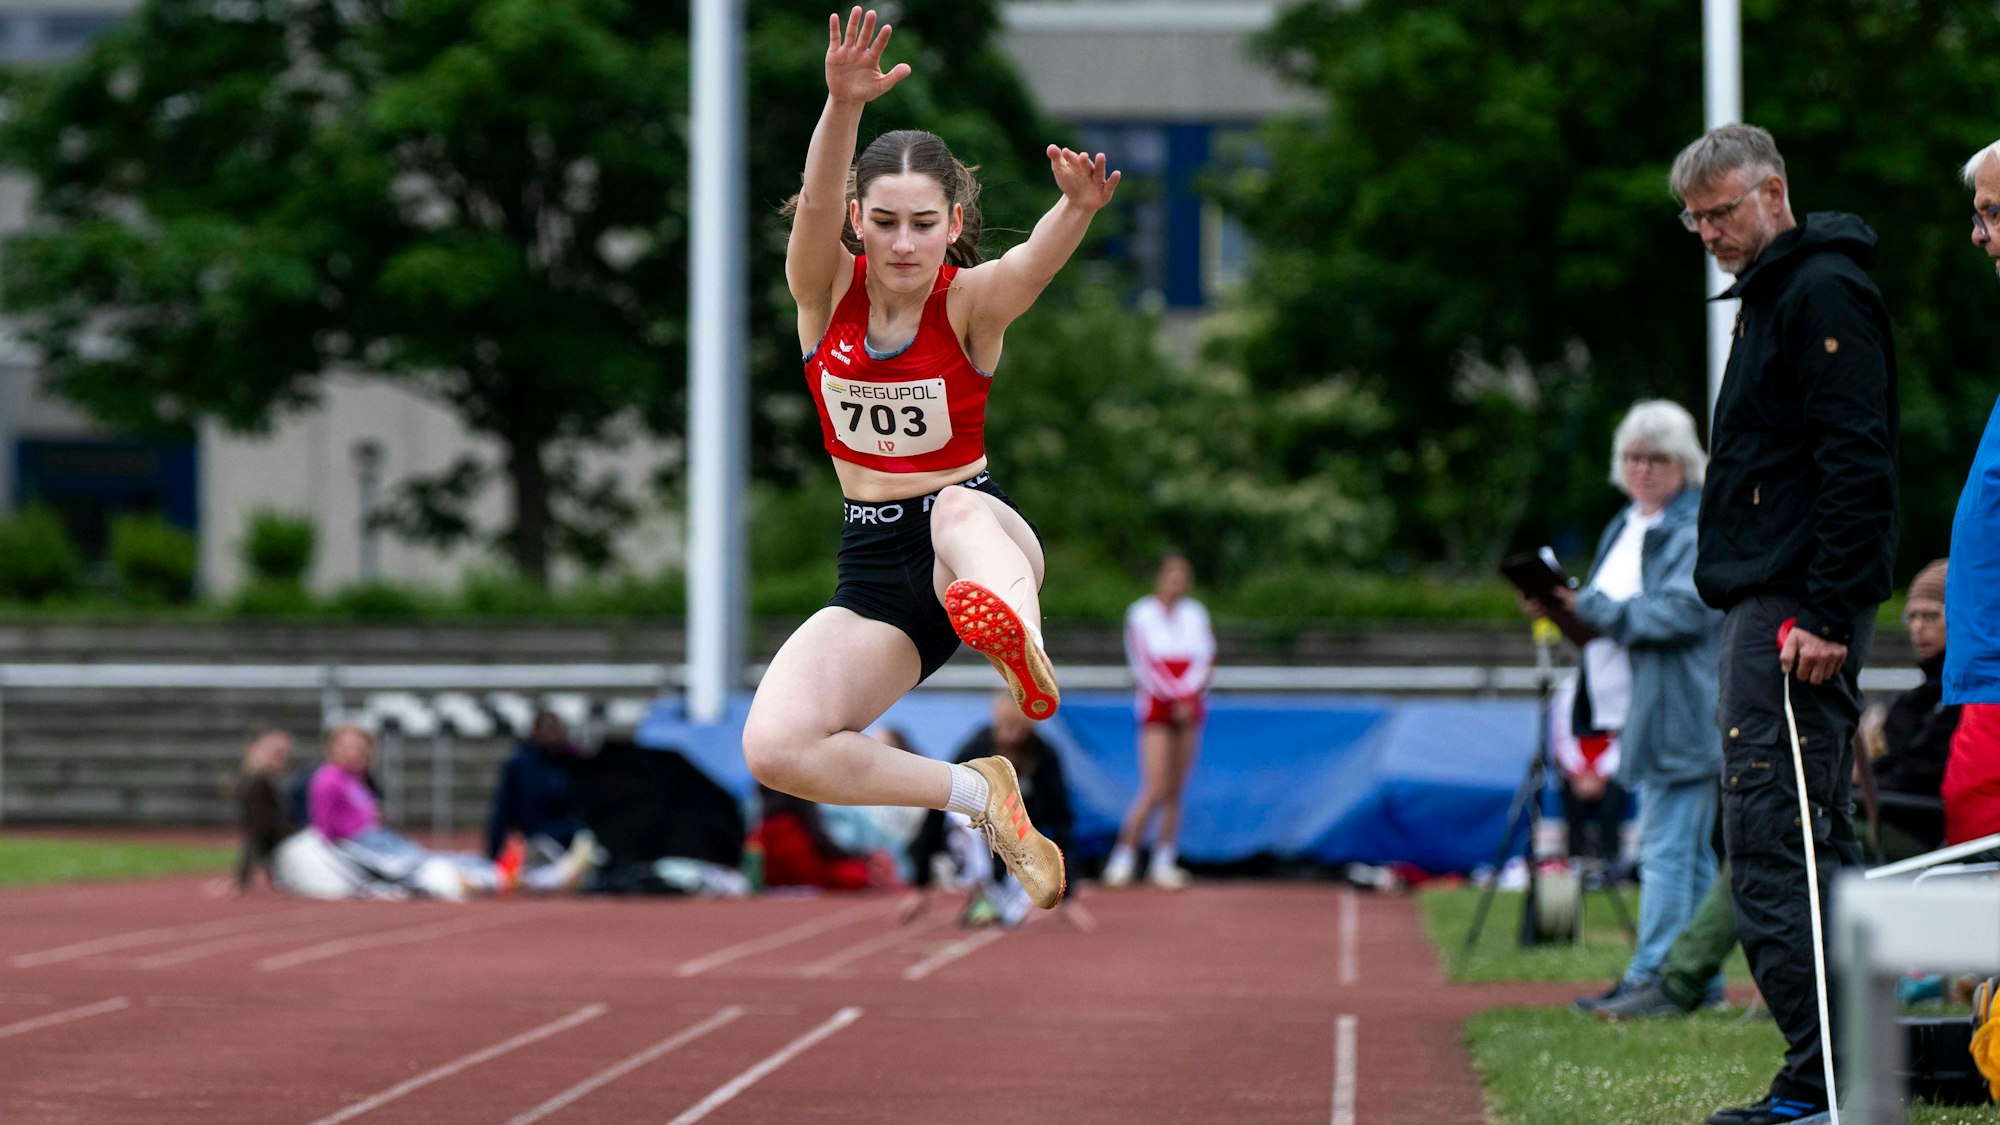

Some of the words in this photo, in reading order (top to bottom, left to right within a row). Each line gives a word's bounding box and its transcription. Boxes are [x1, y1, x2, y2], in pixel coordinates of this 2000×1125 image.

[831, 349, 851, 366] erima
[849, 384, 938, 400] REGUPOL
[840, 401, 928, 437] 703
[850, 504, 904, 525] PRO
